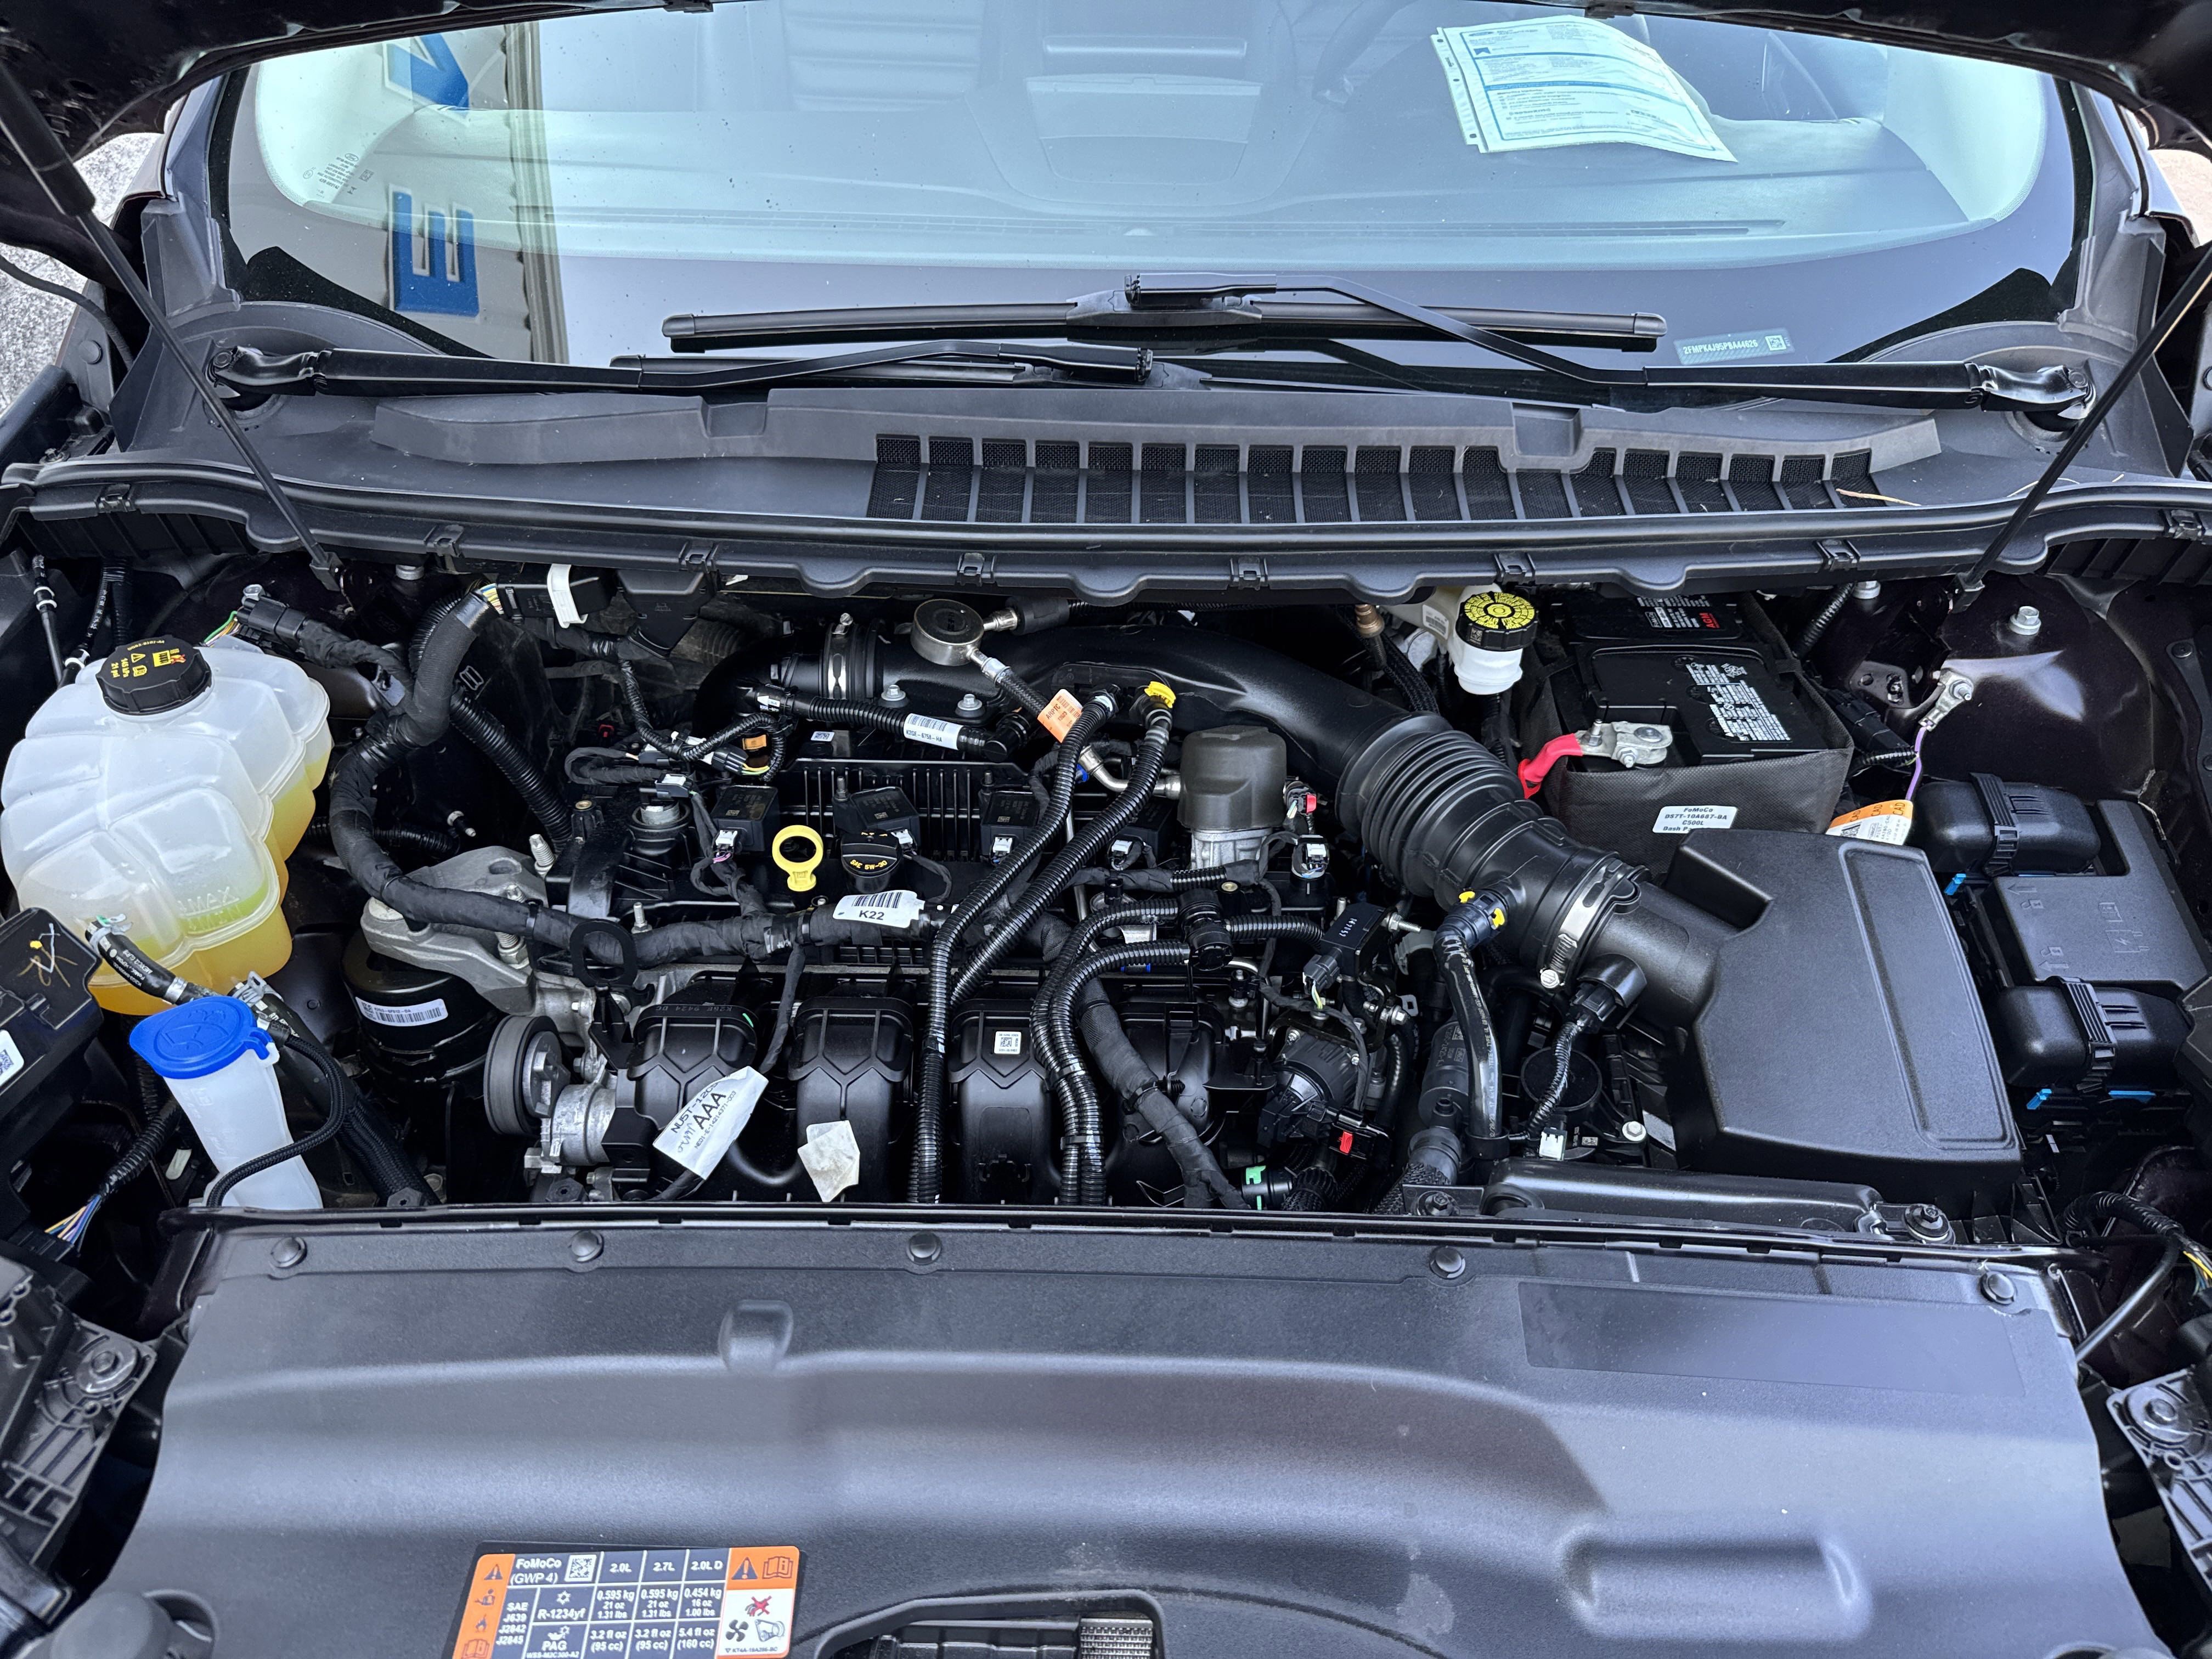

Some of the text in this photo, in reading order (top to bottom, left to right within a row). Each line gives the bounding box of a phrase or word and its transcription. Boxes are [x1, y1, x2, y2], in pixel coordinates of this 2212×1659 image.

[1699, 613, 1716, 628] AGM
[1871, 804, 1883, 816] CAD
[1893, 802, 1905, 815] CAD
[1850, 810, 1861, 822] CAD
[850, 860, 887, 870] SAE 5W-30
[859, 910, 884, 921] K22
[693, 1091, 727, 1130] AAA
[515, 1558, 562, 1568] FoMoCo
[610, 1563, 631, 1572] 2.0L
[653, 1562, 675, 1571] 2.7L
[691, 1560, 723, 1571] 2.0L D
[510, 1573, 558, 1585] (GWP 4)
[597, 1590, 635, 1601] 0.595 kg
[641, 1589, 678, 1600] 0.595 kg
[684, 1588, 722, 1599] 0.454 kg
[506, 1602, 528, 1611] SAE
[503, 1613, 527, 1622] J639
[537, 1608, 586, 1621] R-1234yf
[642, 1610, 657, 1618] 1.31
[498, 1624, 527, 1633] J2842
[635, 1629, 672, 1638] 3.2 fl oz
[679, 1628, 693, 1637] 5.4
[695, 1628, 702, 1636] fl
[495, 1635, 524, 1645] J2845
[590, 1630, 627, 1640] 3.2 fl oz
[542, 1640, 567, 1650] PAG
[591, 1641, 623, 1653] (95 cc)
[636, 1640, 668, 1652] (95 cc)
[677, 1639, 714, 1650] (160 cc)
